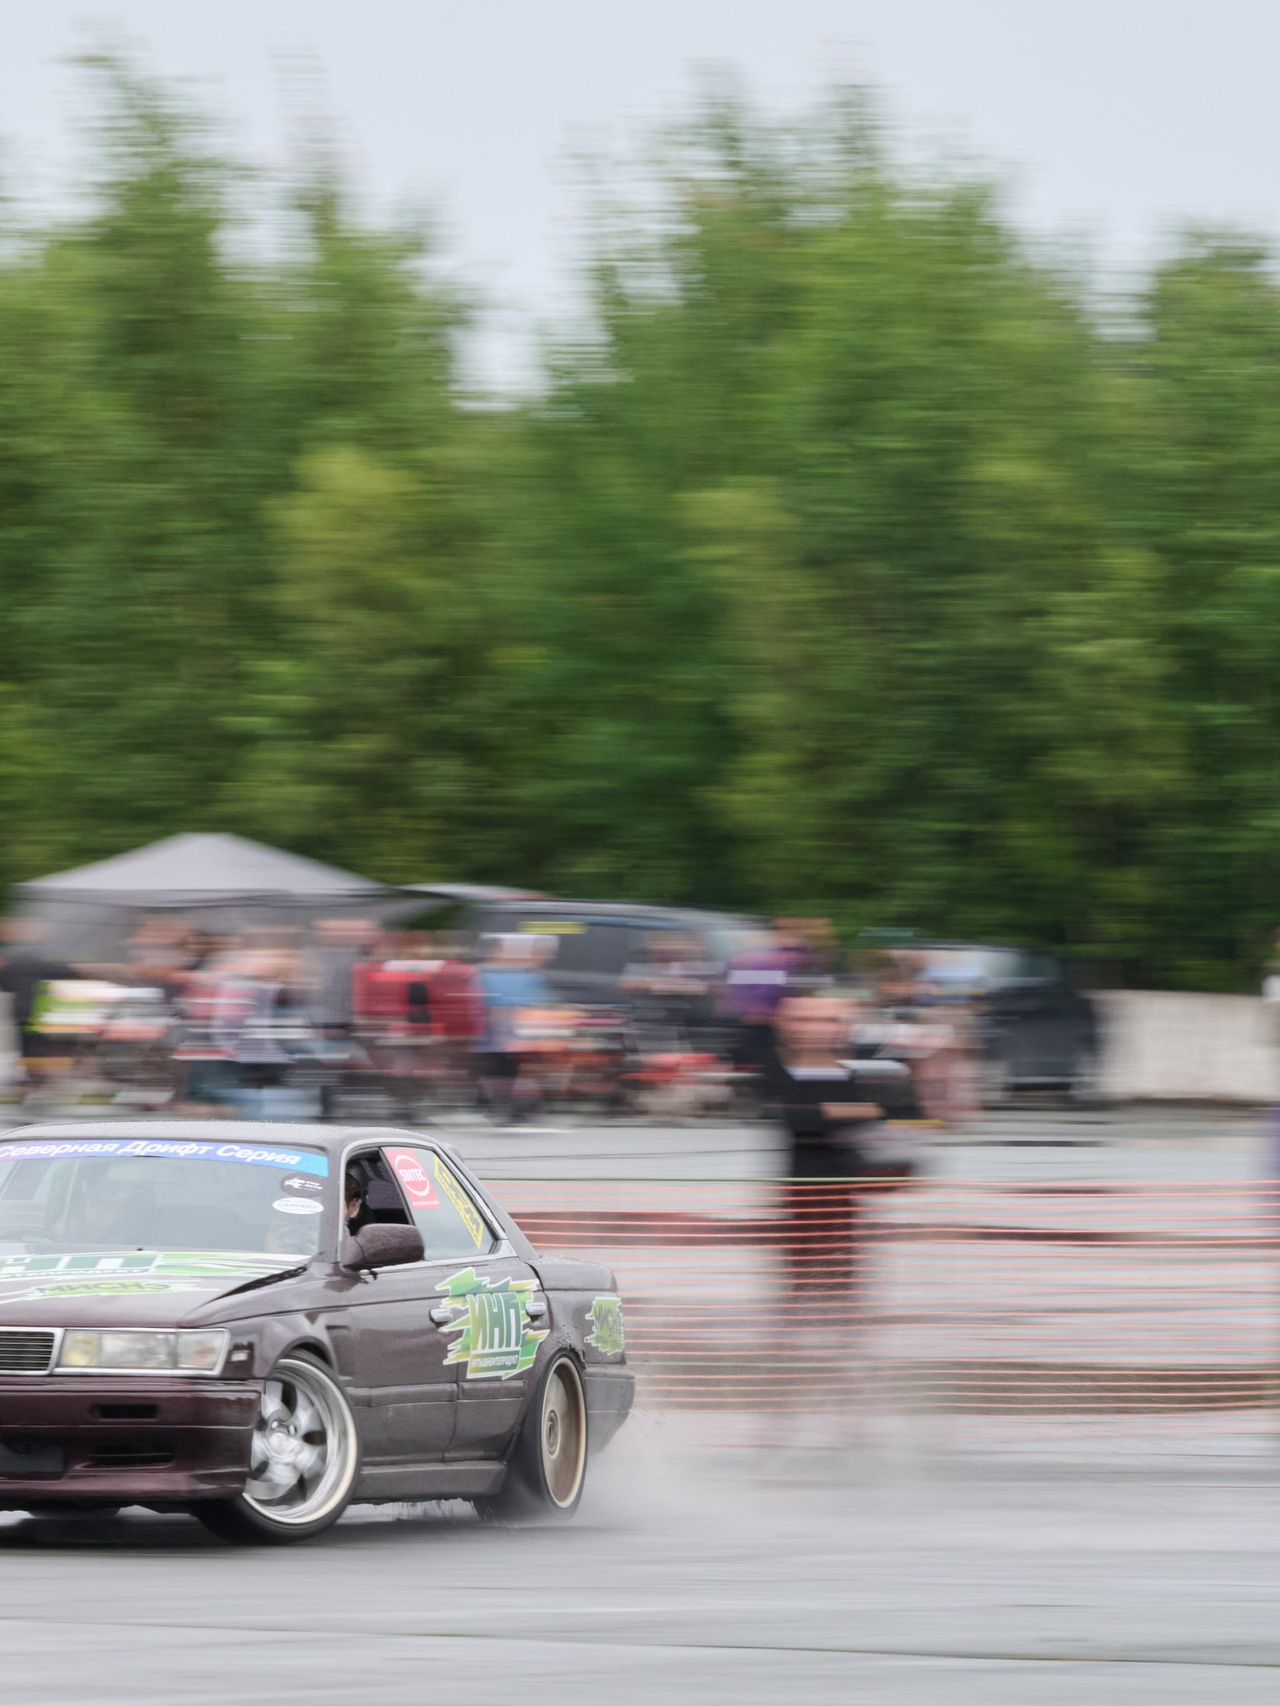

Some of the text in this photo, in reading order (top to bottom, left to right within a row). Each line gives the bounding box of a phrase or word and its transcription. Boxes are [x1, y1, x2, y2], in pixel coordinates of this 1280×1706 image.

[116, 1141, 213, 1156] Дрифт
[216, 1145, 301, 1165] Серия
[398, 1168, 427, 1182] SINTEC
[35, 1282, 170, 1292] МИСНЭ
[466, 1293, 521, 1350] ИНП
